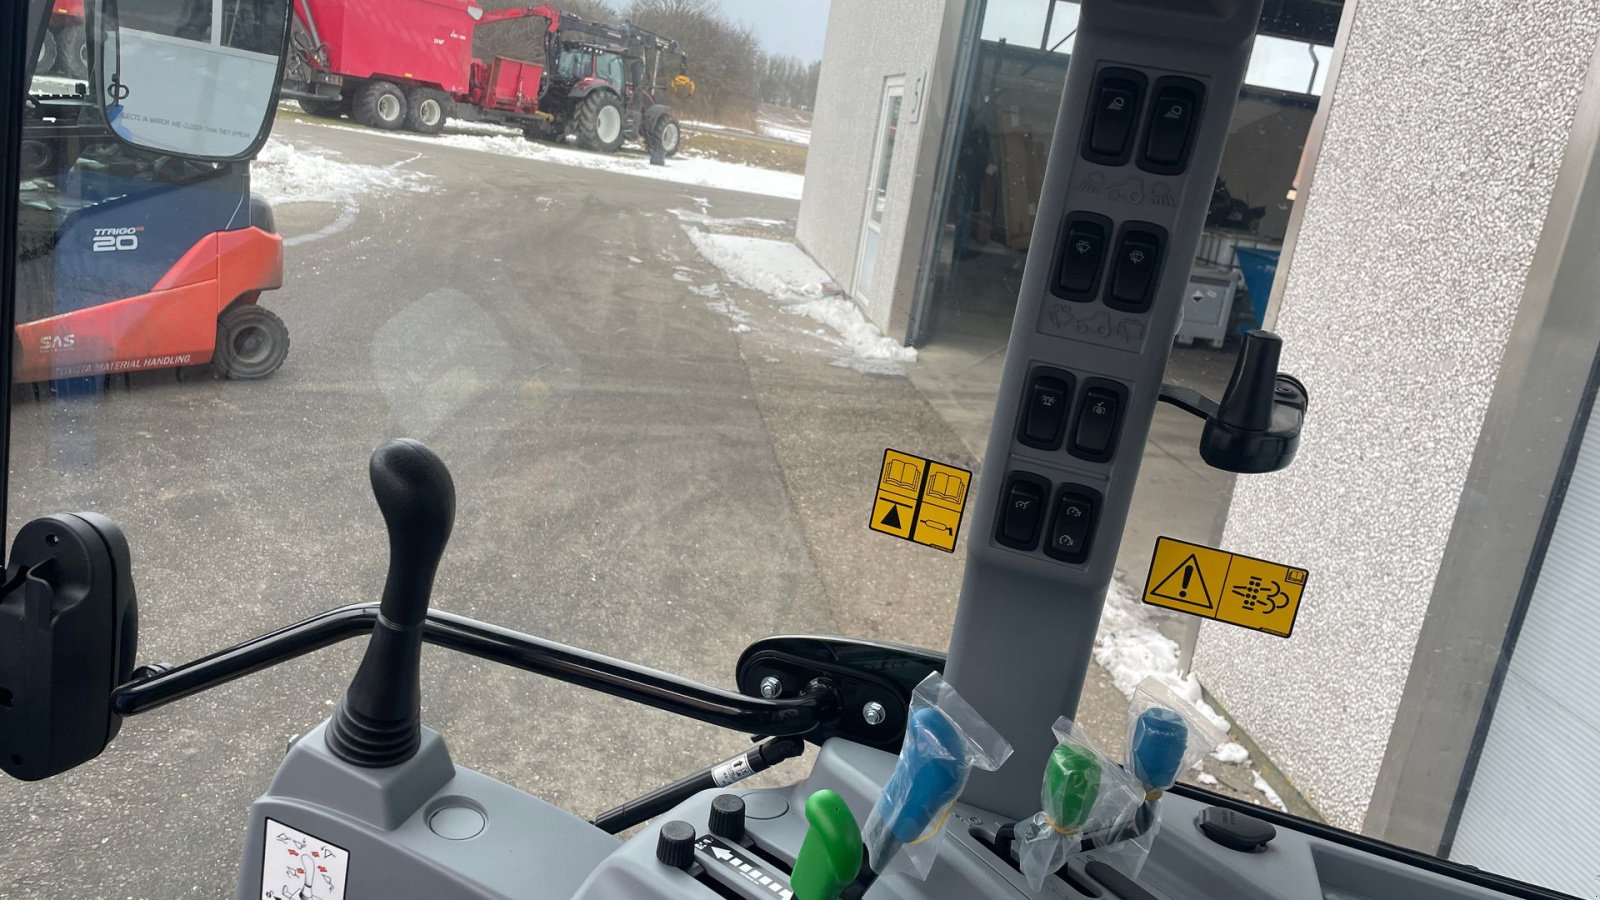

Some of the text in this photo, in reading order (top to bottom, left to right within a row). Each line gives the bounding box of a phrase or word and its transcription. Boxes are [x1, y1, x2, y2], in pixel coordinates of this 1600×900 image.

[93, 235, 138, 252] 20
[39, 334, 75, 350] SAS
[95, 360, 141, 372] MATERIAL
[143, 354, 191, 367] HANDLING
